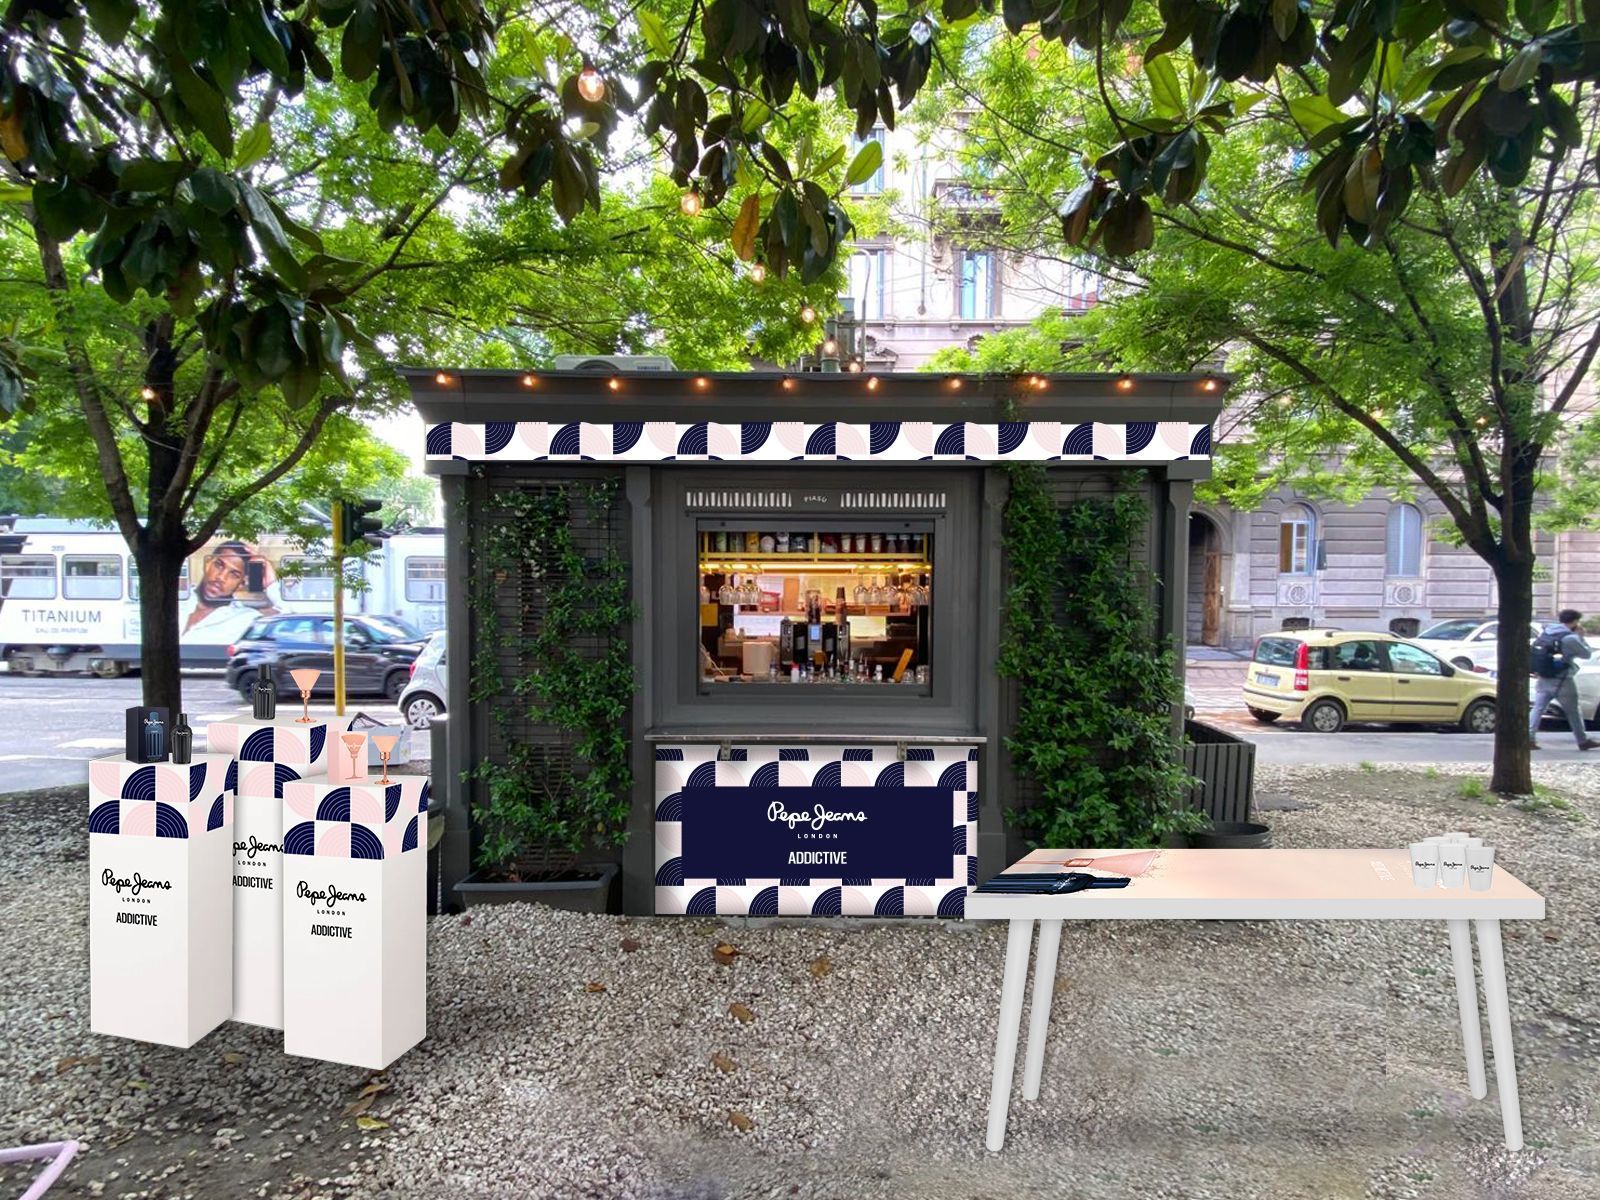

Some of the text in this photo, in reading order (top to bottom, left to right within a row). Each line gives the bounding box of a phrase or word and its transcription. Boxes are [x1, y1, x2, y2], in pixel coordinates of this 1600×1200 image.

[21, 609, 101, 623] TITANIUM
[767, 801, 868, 831] Pepe Jeans
[232, 841, 248, 857] pe
[788, 851, 848, 865] ADDICTIVE
[102, 868, 172, 896] Pepe Jeans
[232, 875, 273, 890] ADDICTIVE
[296, 880, 367, 908] Pepe Jeans
[116, 911, 158, 927] ADDICTIVE
[311, 924, 352, 939] ADDICTIVE
